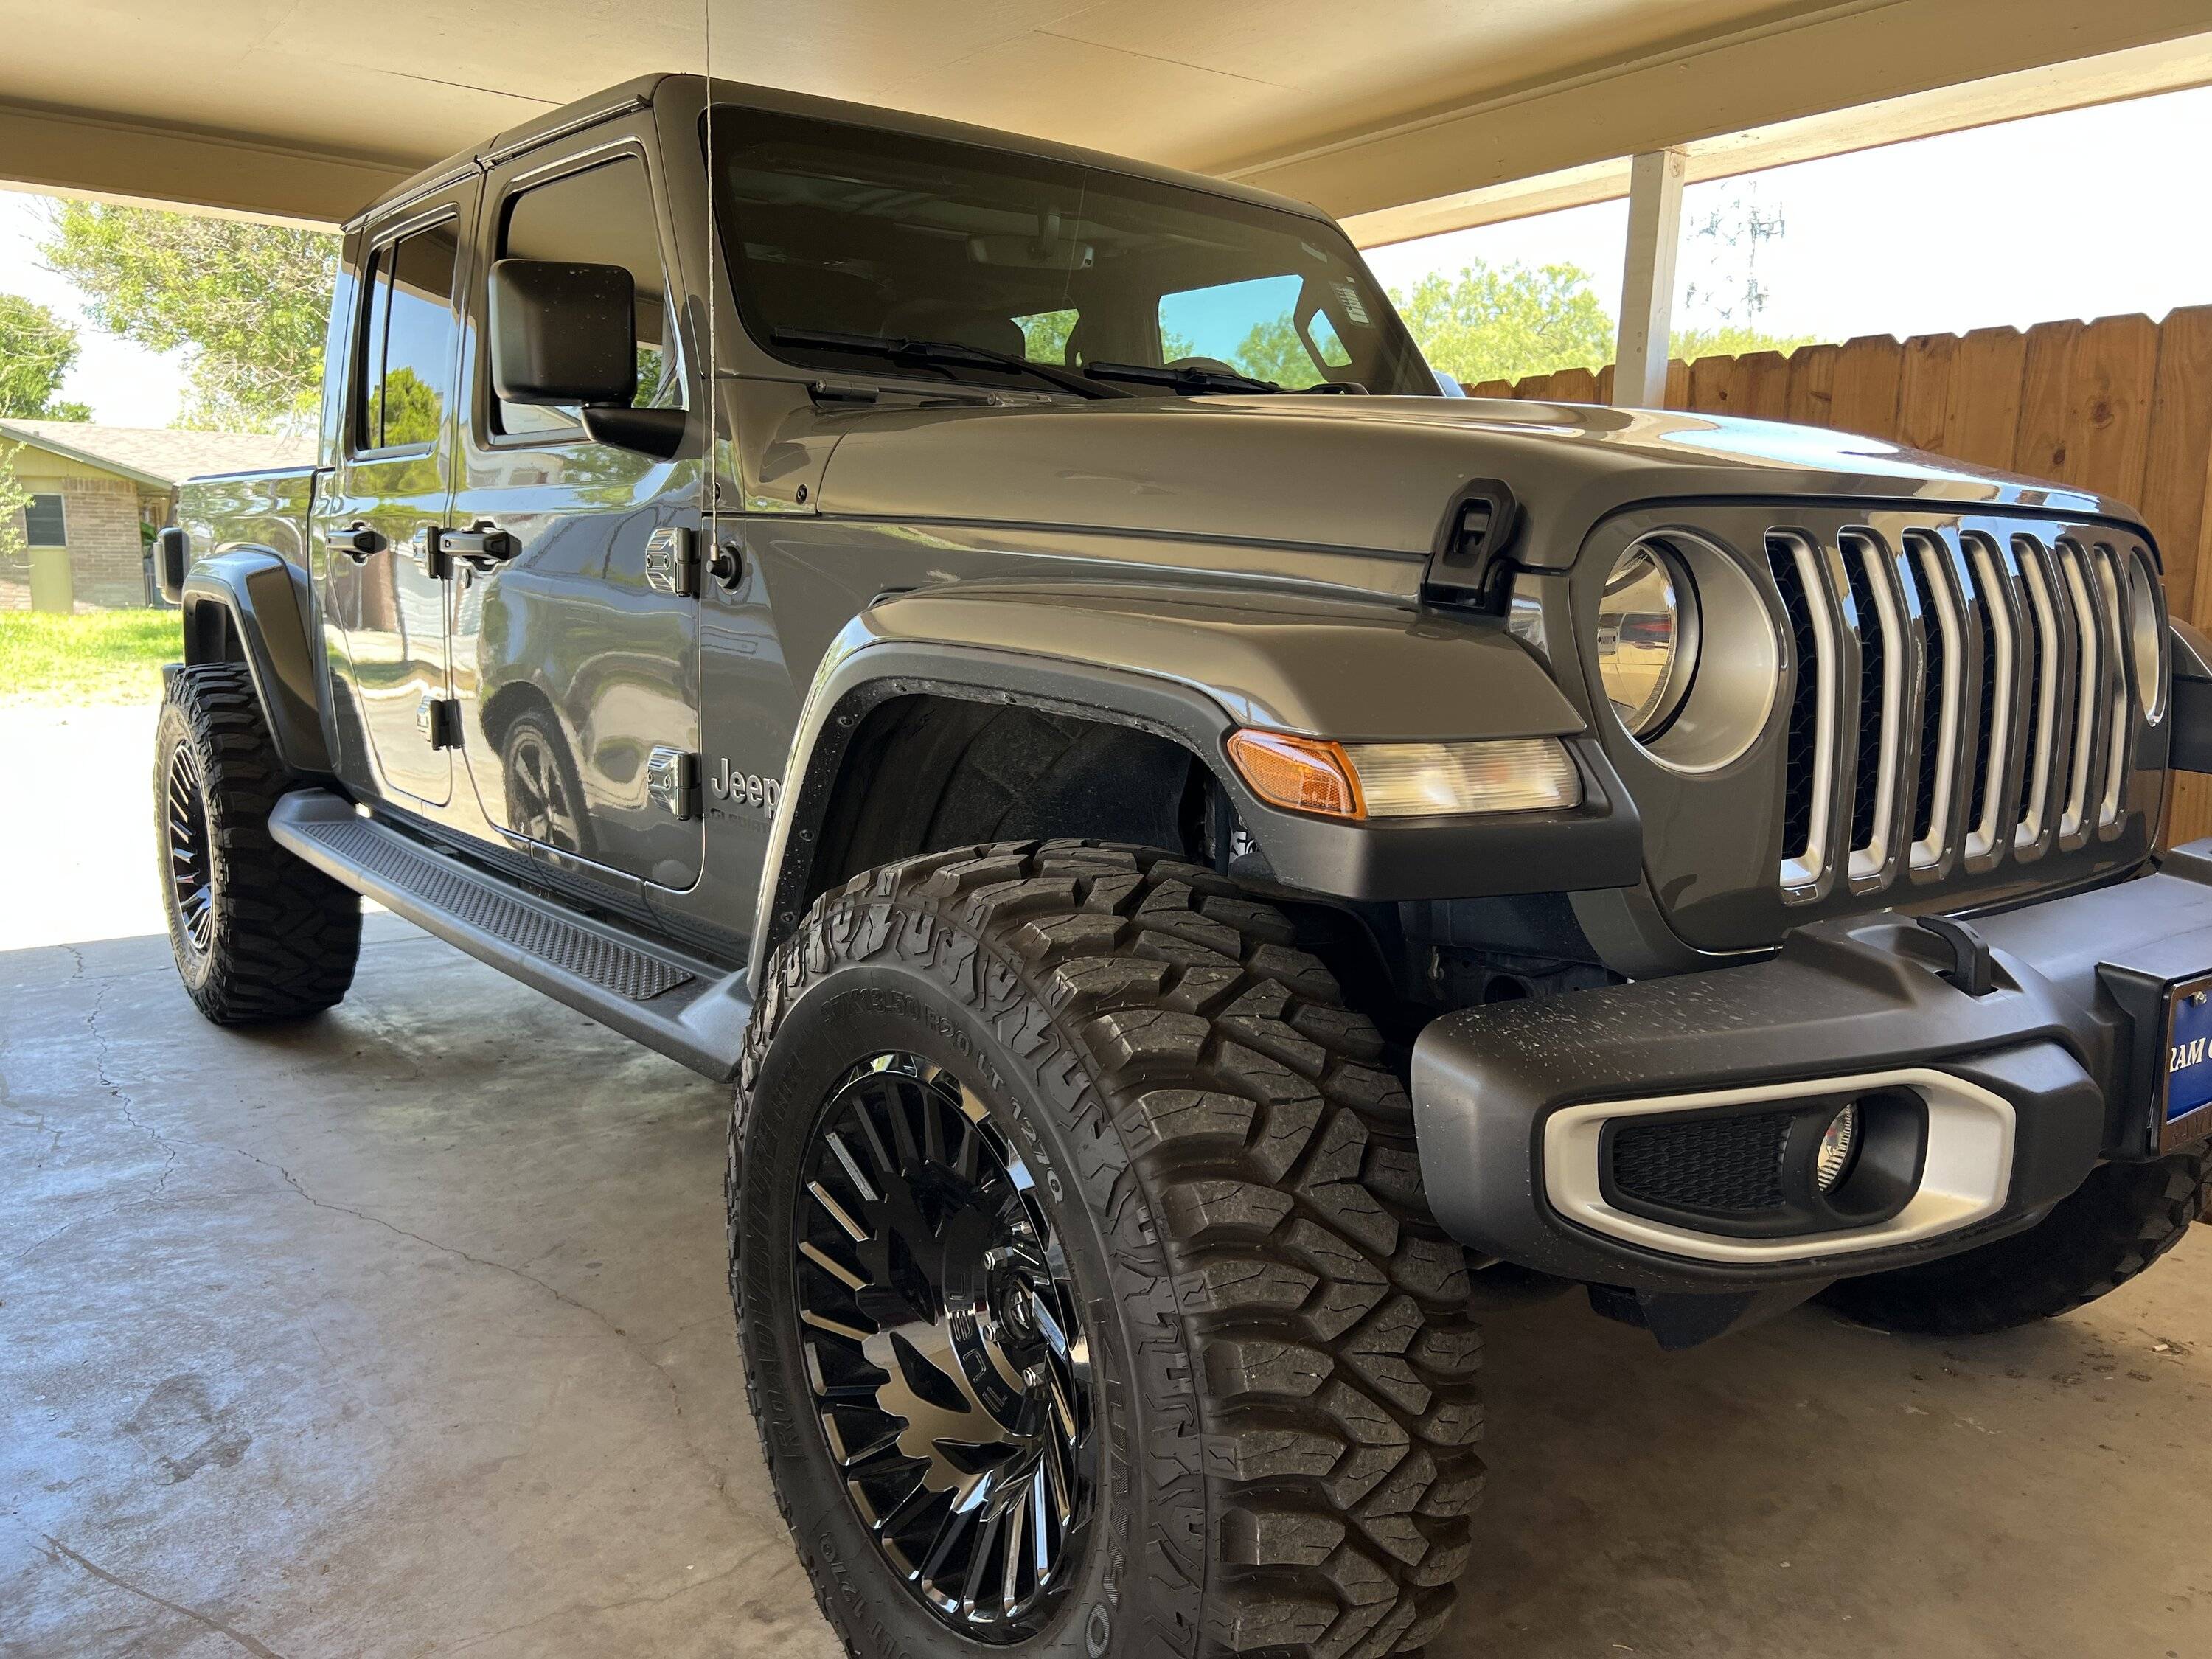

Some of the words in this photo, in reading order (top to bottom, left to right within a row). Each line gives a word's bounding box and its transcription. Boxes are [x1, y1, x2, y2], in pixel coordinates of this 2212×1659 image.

[710, 757, 782, 820] Jeep
[924, 1004, 973, 1057] R20
[977, 1051, 1006, 1091] LT
[1009, 1096, 1064, 1204] 127Q
[1085, 1299, 1133, 1658] KUMHO
